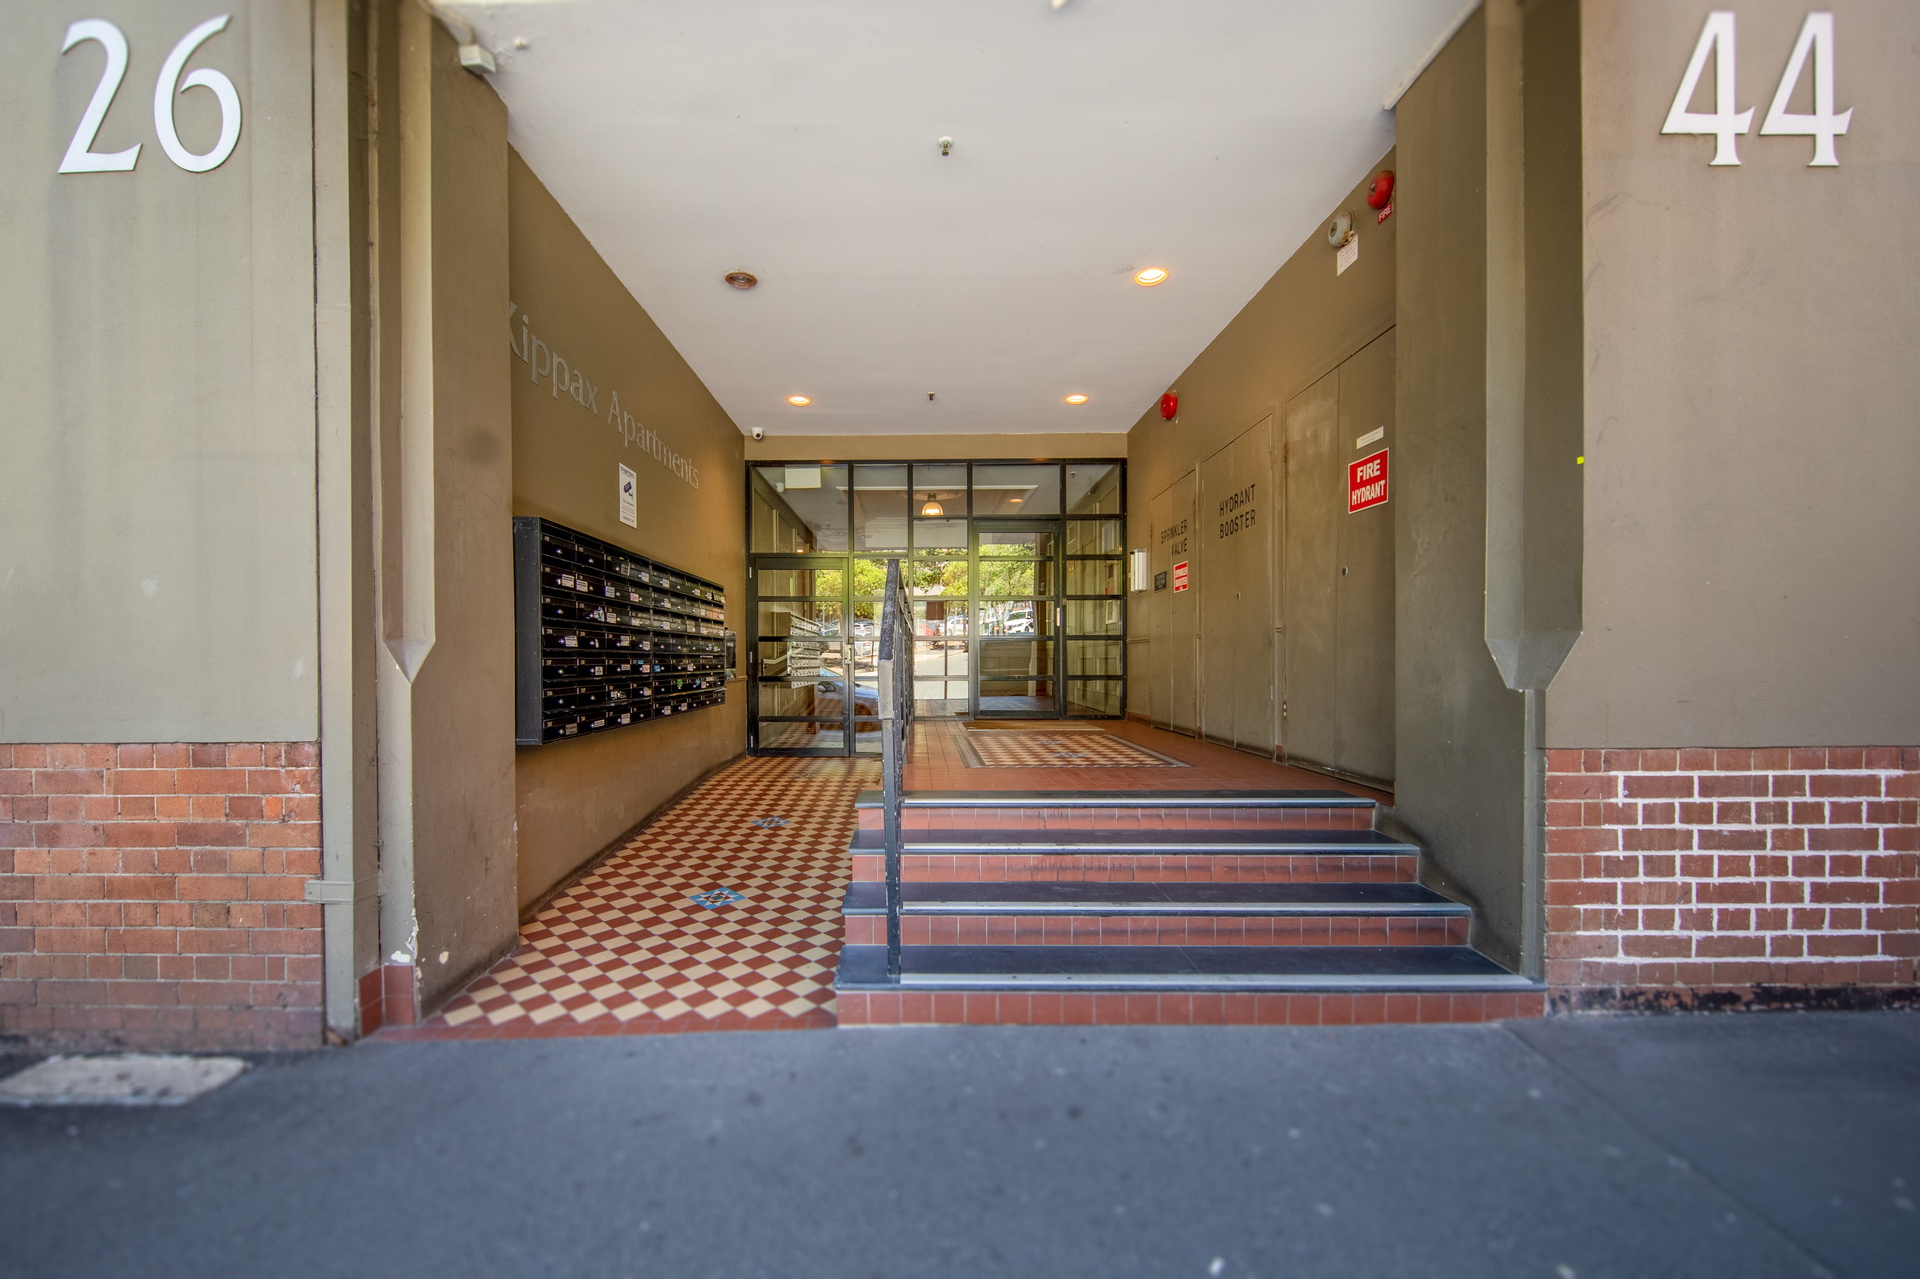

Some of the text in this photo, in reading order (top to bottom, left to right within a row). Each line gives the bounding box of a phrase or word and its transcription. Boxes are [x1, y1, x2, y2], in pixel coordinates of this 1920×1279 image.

[57, 13, 242, 174] 26
[1660, 10, 1854, 167] 44
[1378, 203, 1392, 222] FIRE
[607, 390, 699, 490] Apartments
[1356, 458, 1381, 483] FIRE
[1219, 483, 1256, 517] HYDRANT
[1351, 479, 1385, 506] HYDRANT
[1160, 518, 1188, 544] SPRINKLER
[1219, 510, 1256, 540] BOOSTER
[1171, 537, 1188, 557] VALVE
